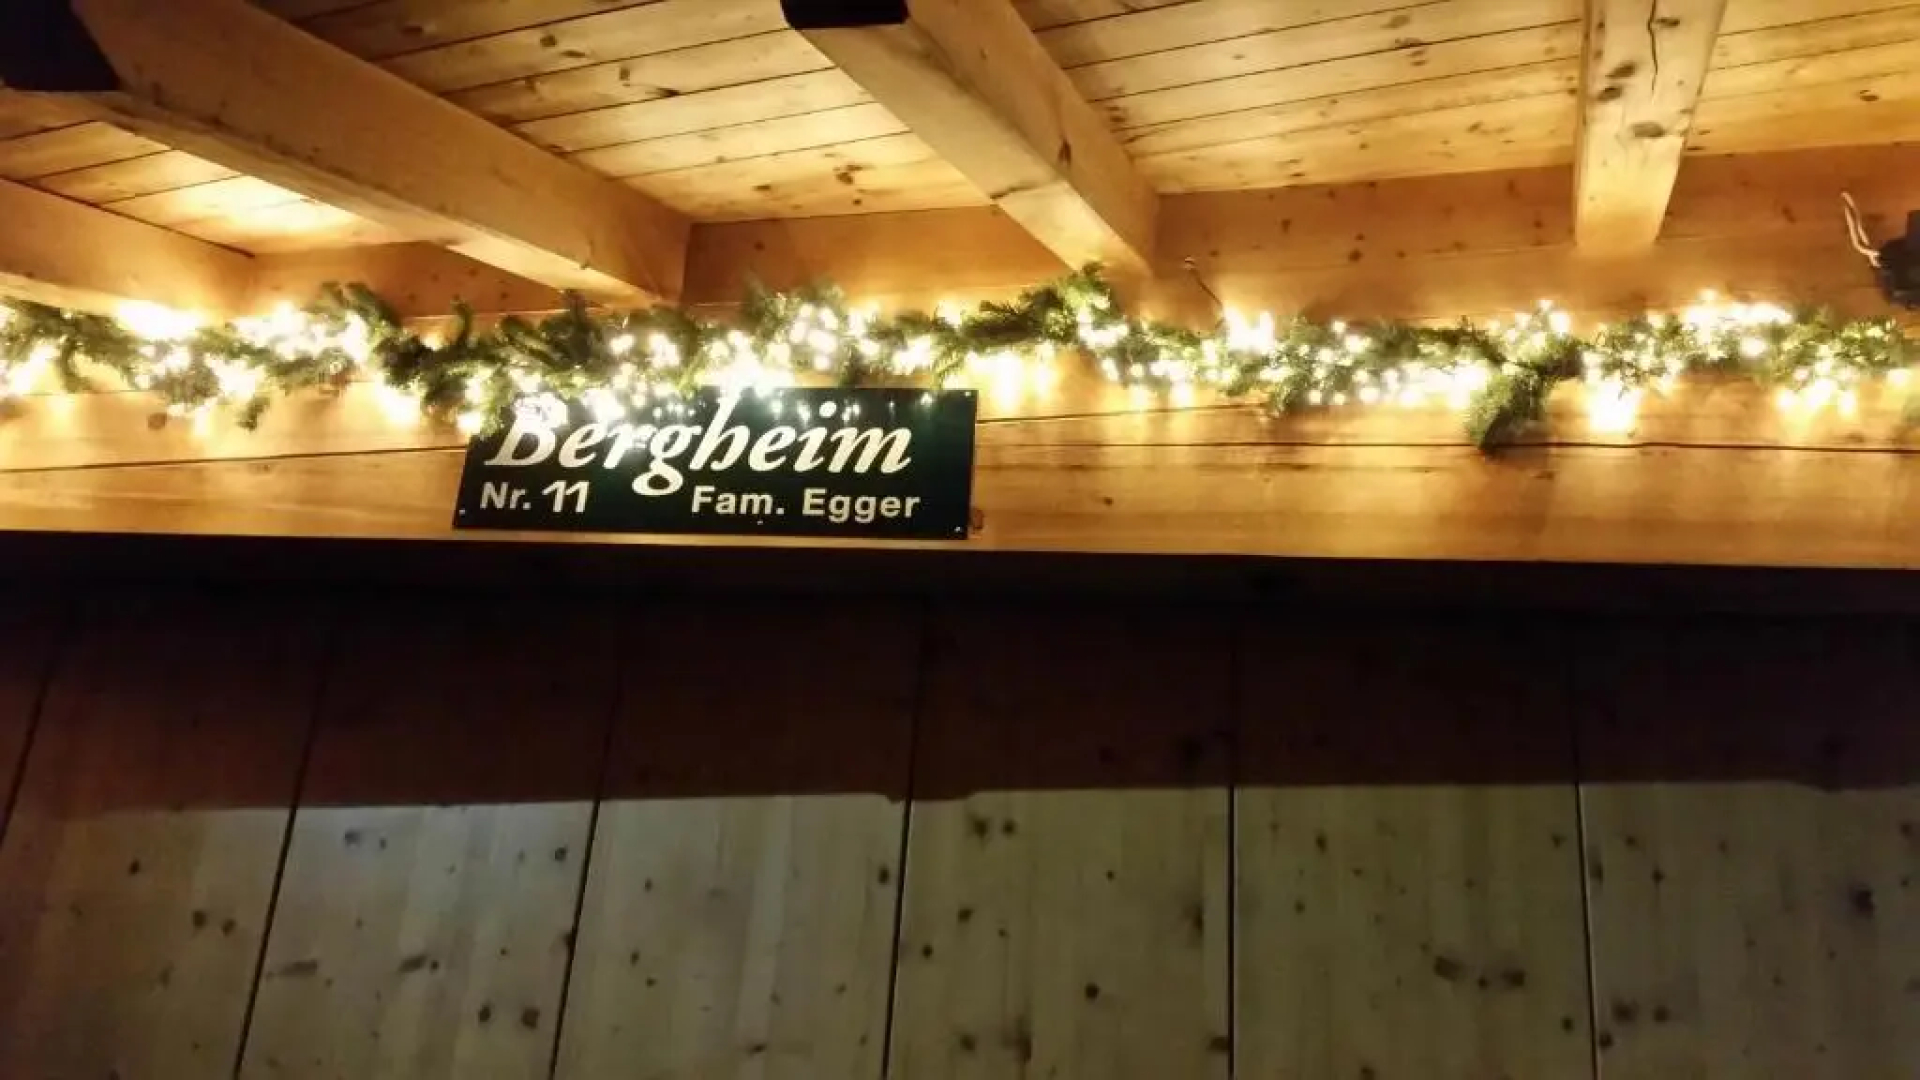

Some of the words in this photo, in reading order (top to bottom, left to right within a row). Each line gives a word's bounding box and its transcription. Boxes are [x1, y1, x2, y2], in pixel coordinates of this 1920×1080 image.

[485, 393, 912, 496] Bergheim
[480, 481, 532, 511] Nr.
[541, 480, 590, 513] 11
[691, 485, 785, 517] Fam.
[802, 488, 921, 523] Egger
